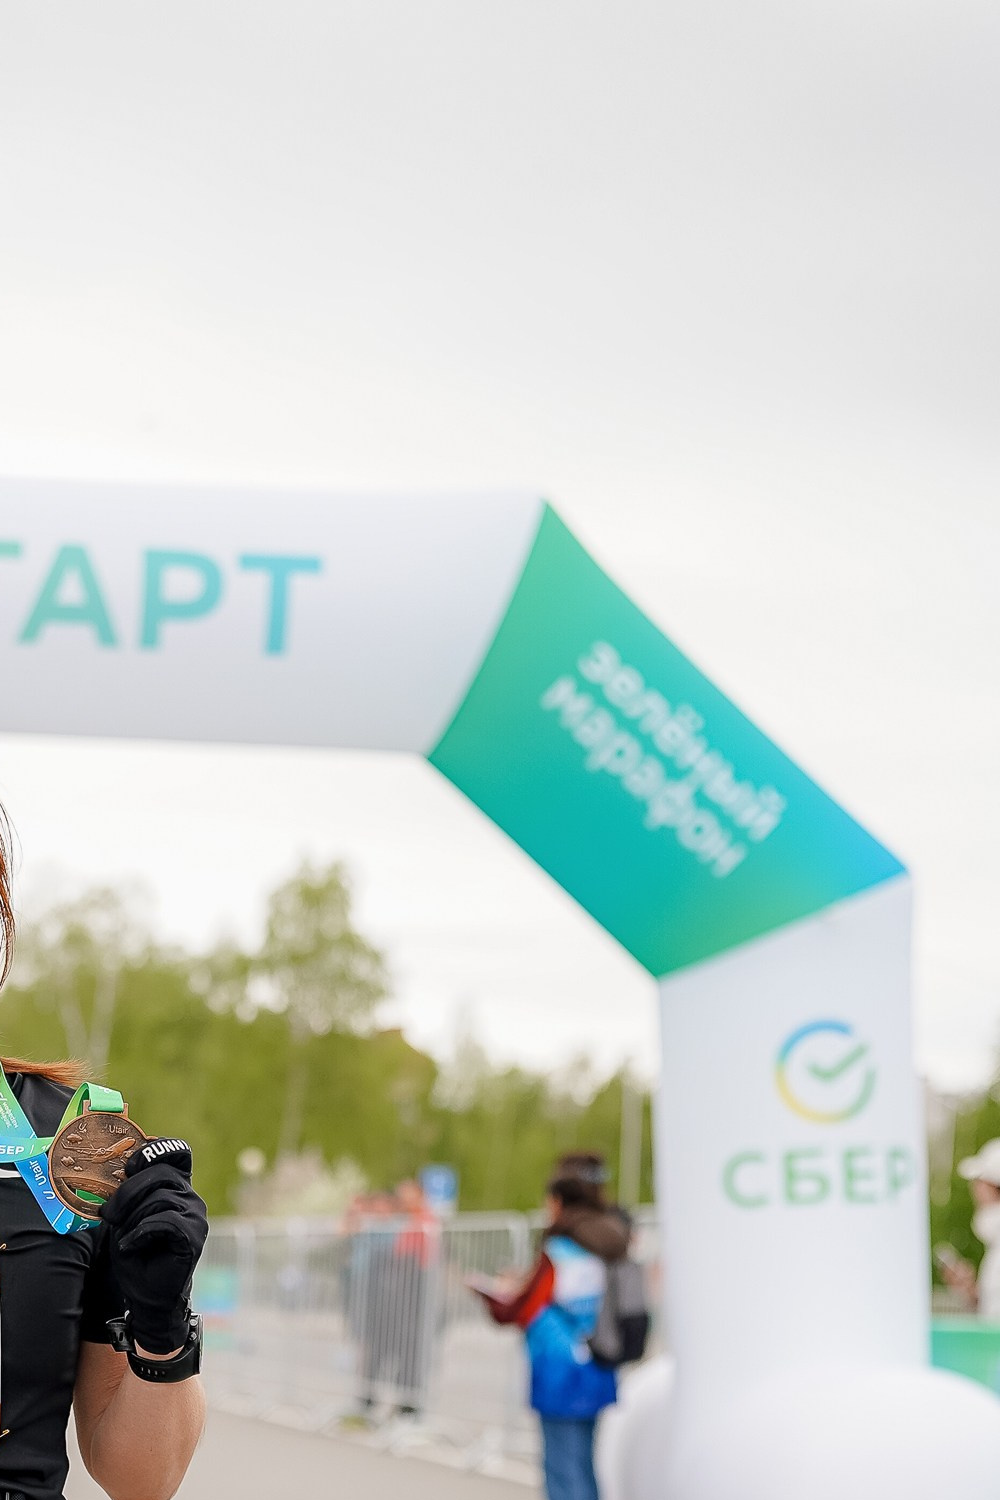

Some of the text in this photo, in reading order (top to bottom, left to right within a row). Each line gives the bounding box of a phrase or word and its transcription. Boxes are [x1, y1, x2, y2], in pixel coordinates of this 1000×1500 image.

[576, 639, 788, 843] зелёный
[540, 675, 747, 879] марафон
[108, 1124, 129, 1134] Utair
[29, 1160, 47, 1186] Utair
[719, 1146, 918, 1210] СБЕР
